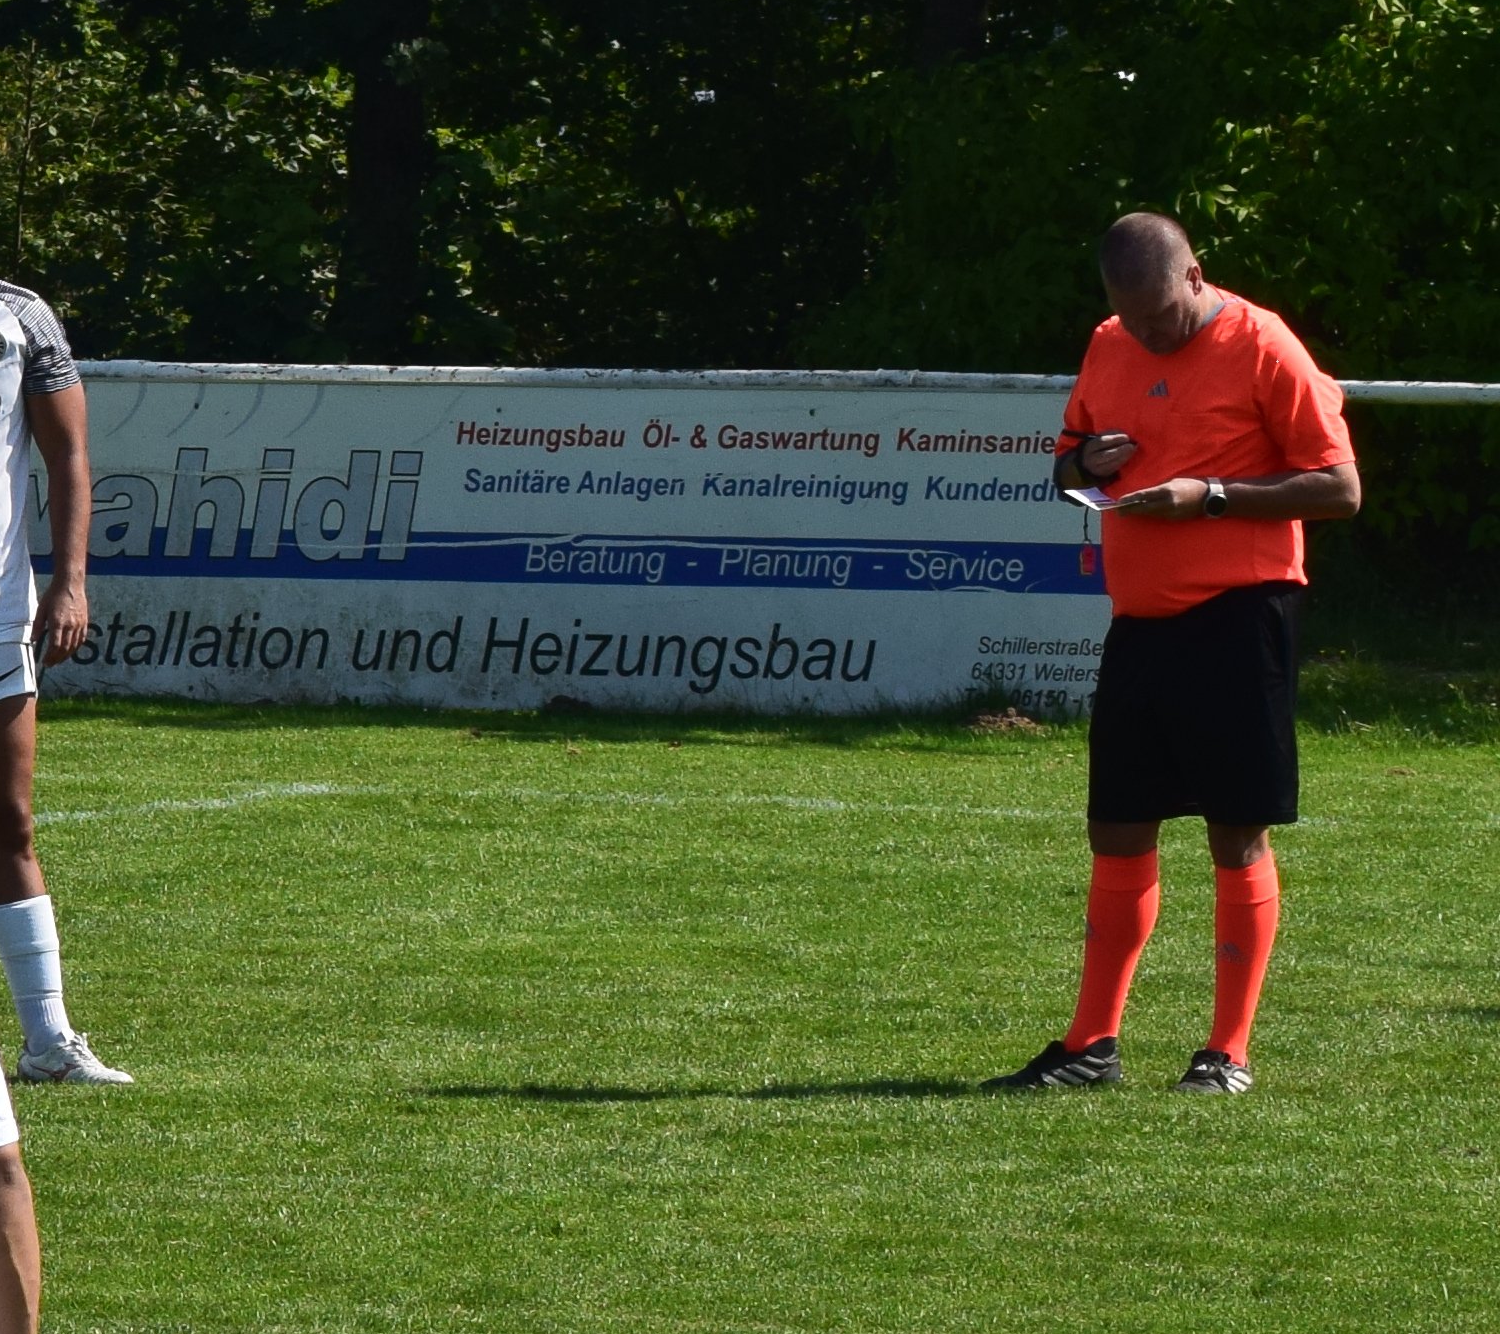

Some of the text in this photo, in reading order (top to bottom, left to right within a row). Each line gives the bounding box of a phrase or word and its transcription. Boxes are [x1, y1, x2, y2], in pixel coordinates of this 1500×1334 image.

[456, 419, 1056, 457] Heizungsbau Öl- & Gaswartung Kaminsanie
[463, 468, 1060, 506] Sanitäre Anlagen Kanalreinigung Kundendi
[525, 544, 666, 583] Beratung
[719, 548, 853, 586] Planung
[904, 549, 1025, 582] Service
[34, 611, 877, 694] stallation und Heizungsbau
[977, 636, 1103, 657] Schillerstraße
[971, 661, 1027, 681] 64331
